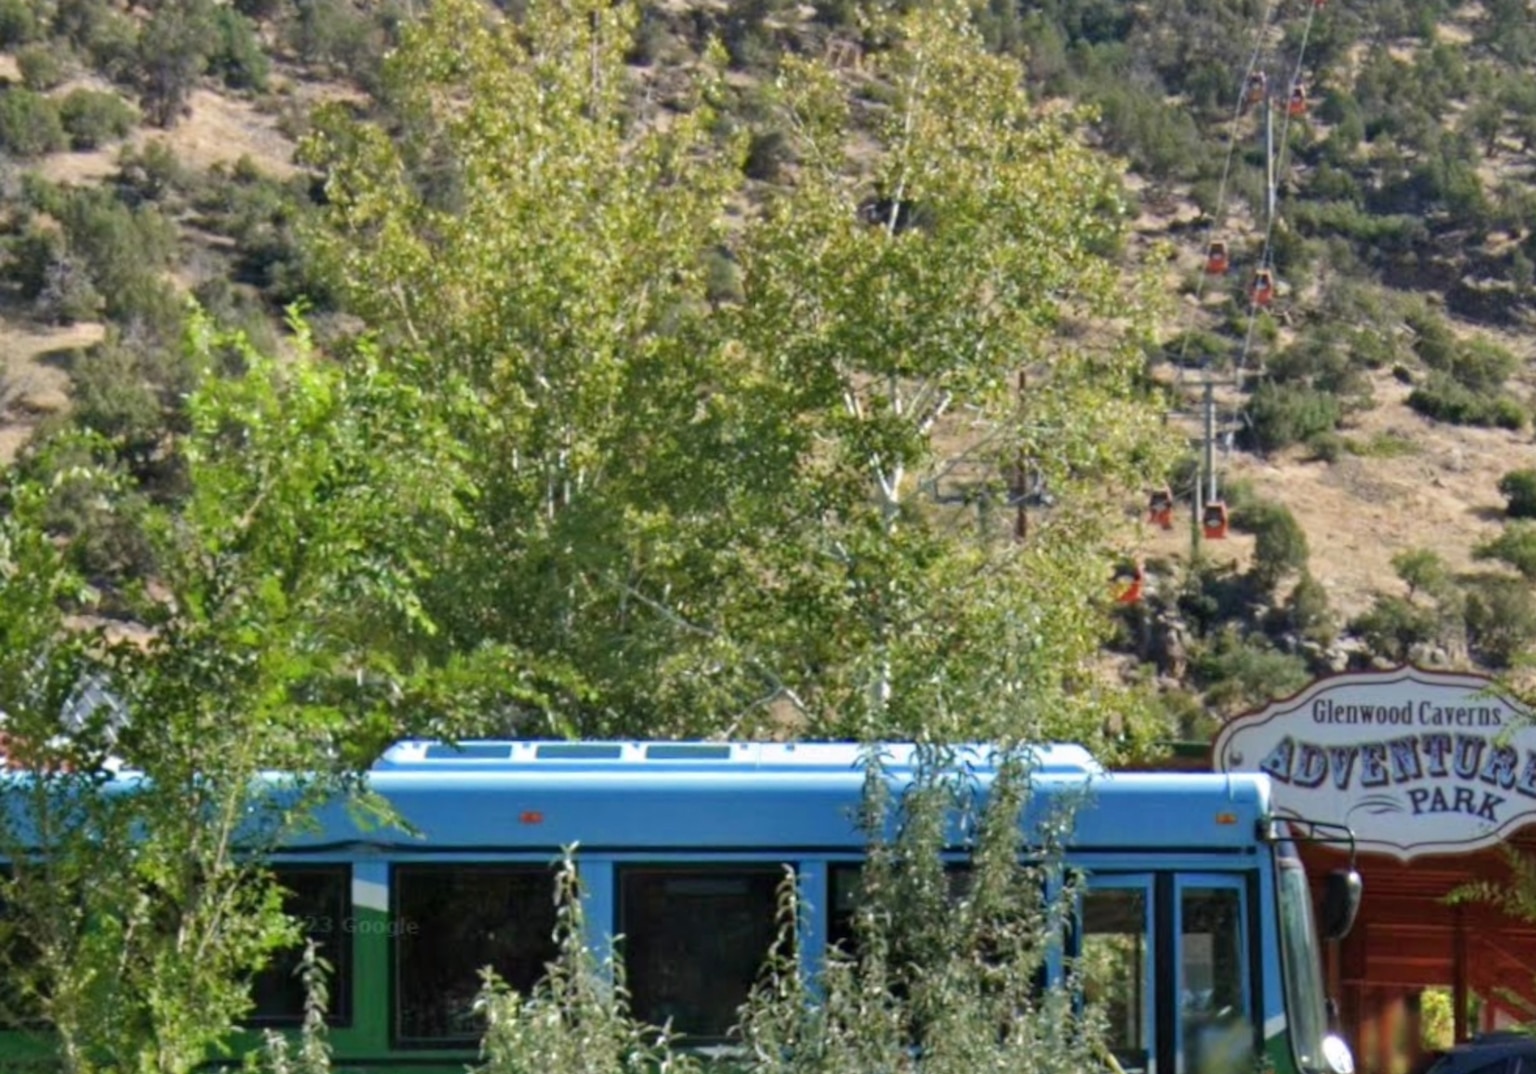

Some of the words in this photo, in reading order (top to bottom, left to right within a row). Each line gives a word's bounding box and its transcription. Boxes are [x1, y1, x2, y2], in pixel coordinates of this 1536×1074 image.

[1311, 700, 1412, 725] Glenwood
[1419, 701, 1502, 726] Caverns
[1406, 785, 1507, 823] PARK
